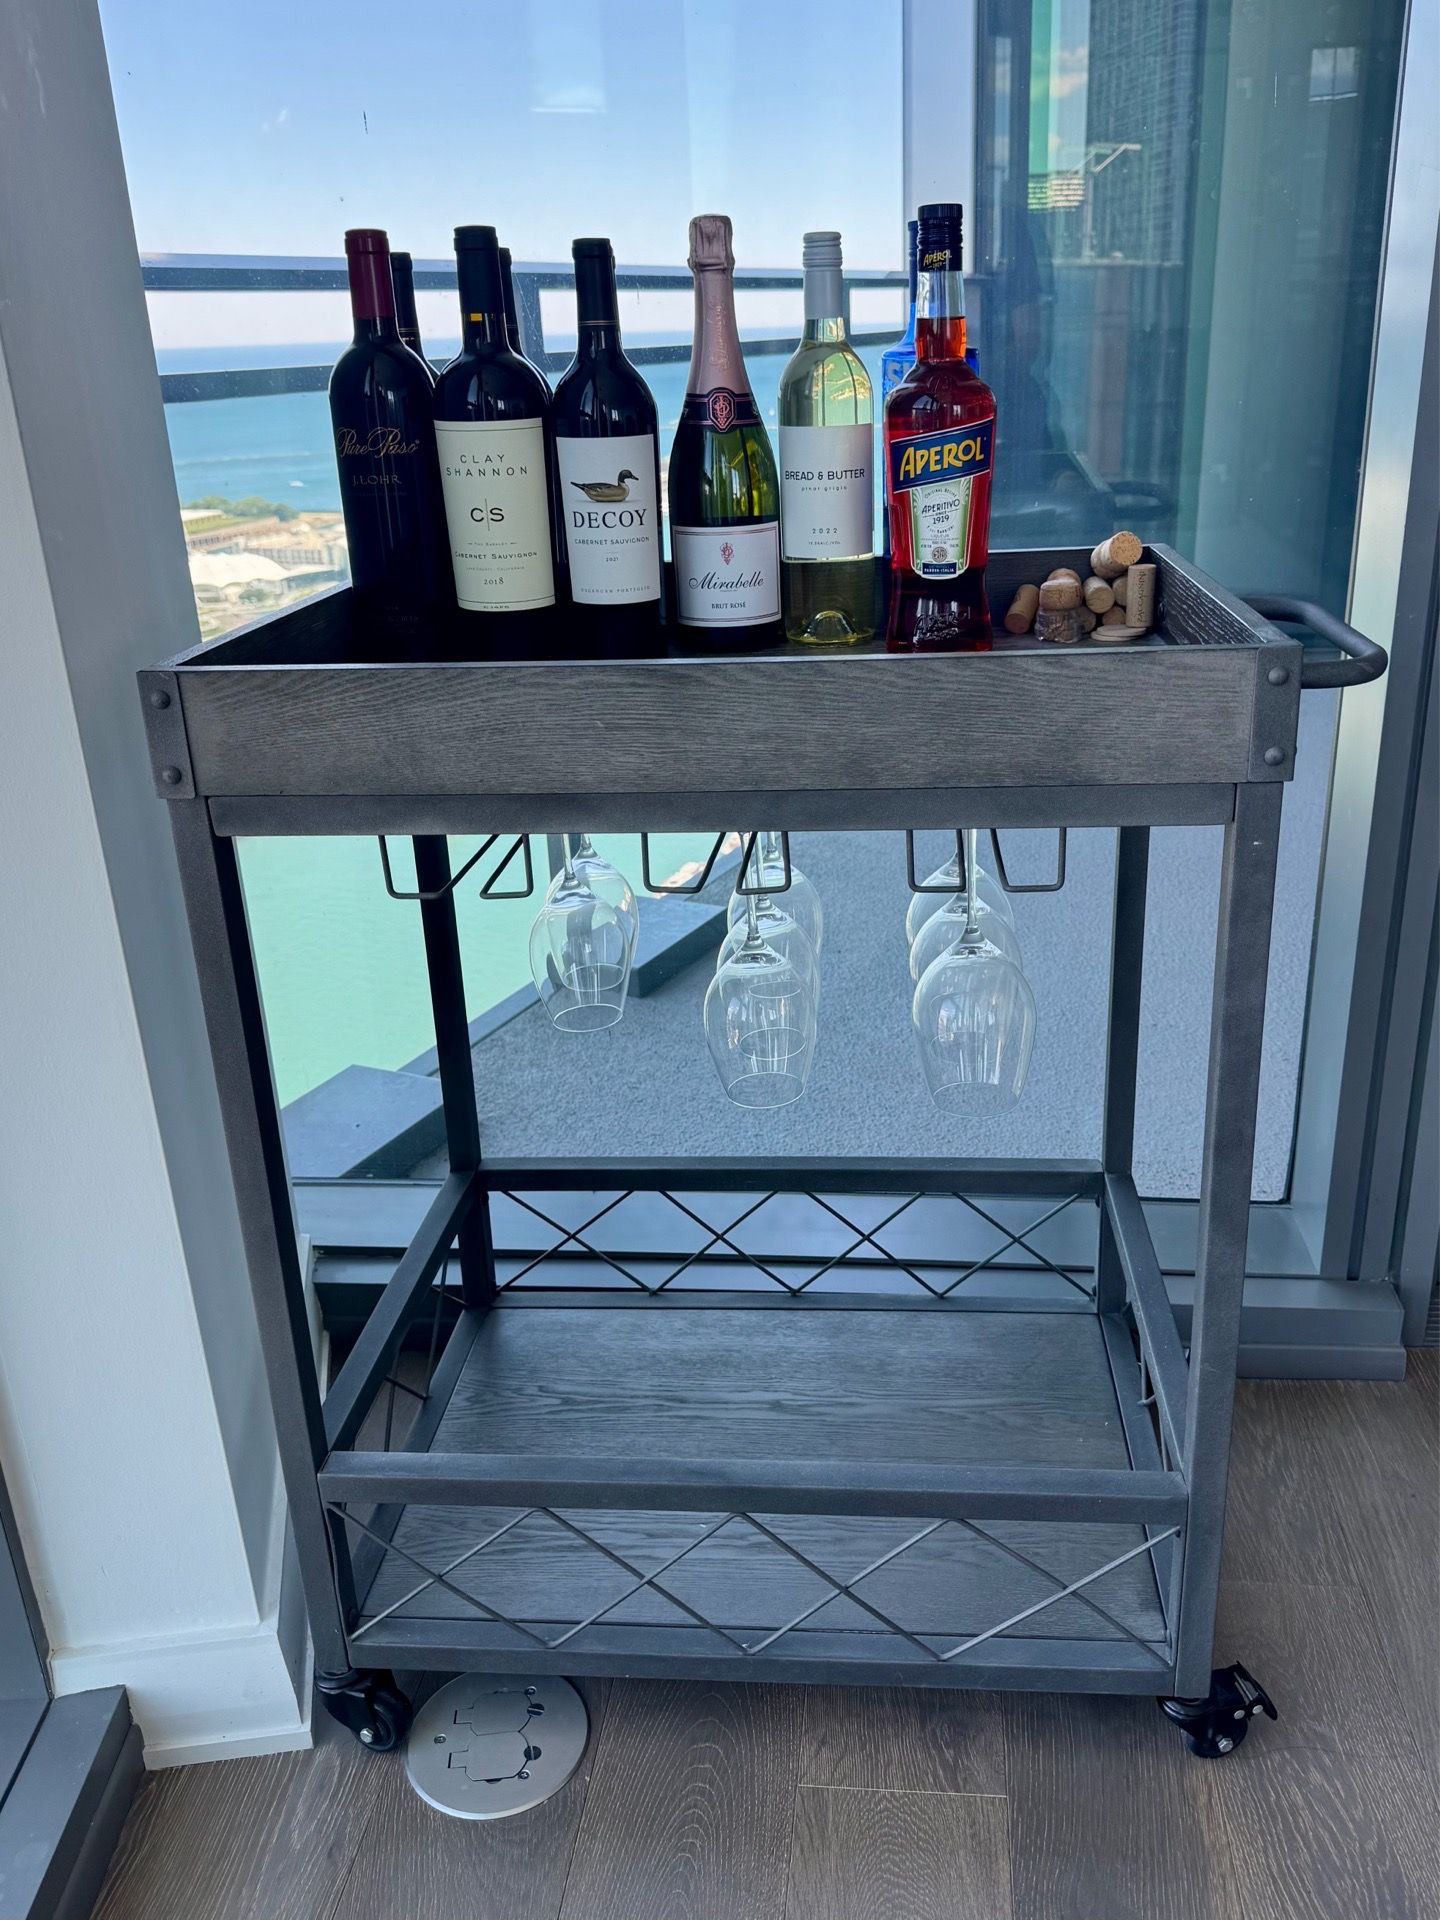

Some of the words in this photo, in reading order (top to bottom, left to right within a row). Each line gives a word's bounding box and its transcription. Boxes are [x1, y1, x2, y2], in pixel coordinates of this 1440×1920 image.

[923, 250, 953, 267] APEROL
[336, 427, 368, 458] Pure
[459, 454, 505, 464] CLAY
[899, 436, 985, 481] APEROL
[446, 465, 528, 477] SHANNON
[785, 470, 815, 481] BREAD
[817, 471, 824, 480] &
[827, 468, 865, 480] BUTTER
[921, 498, 960, 514] APERITIVO
[572, 508, 648, 529] DECOY
[932, 514, 950, 525] 1919
[811, 527, 838, 535] 2022
[575, 538, 608, 546] CABERNET
[610, 536, 650, 546] SAUVIGNON
[454, 551, 487, 560] CABERNET
[491, 551, 538, 560] SAUVIGNON
[483, 576, 505, 586] 2018
[688, 570, 764, 591] Mirabelle
[711, 602, 729, 610] BRUT
[730, 600, 747, 609] ROSÉ
